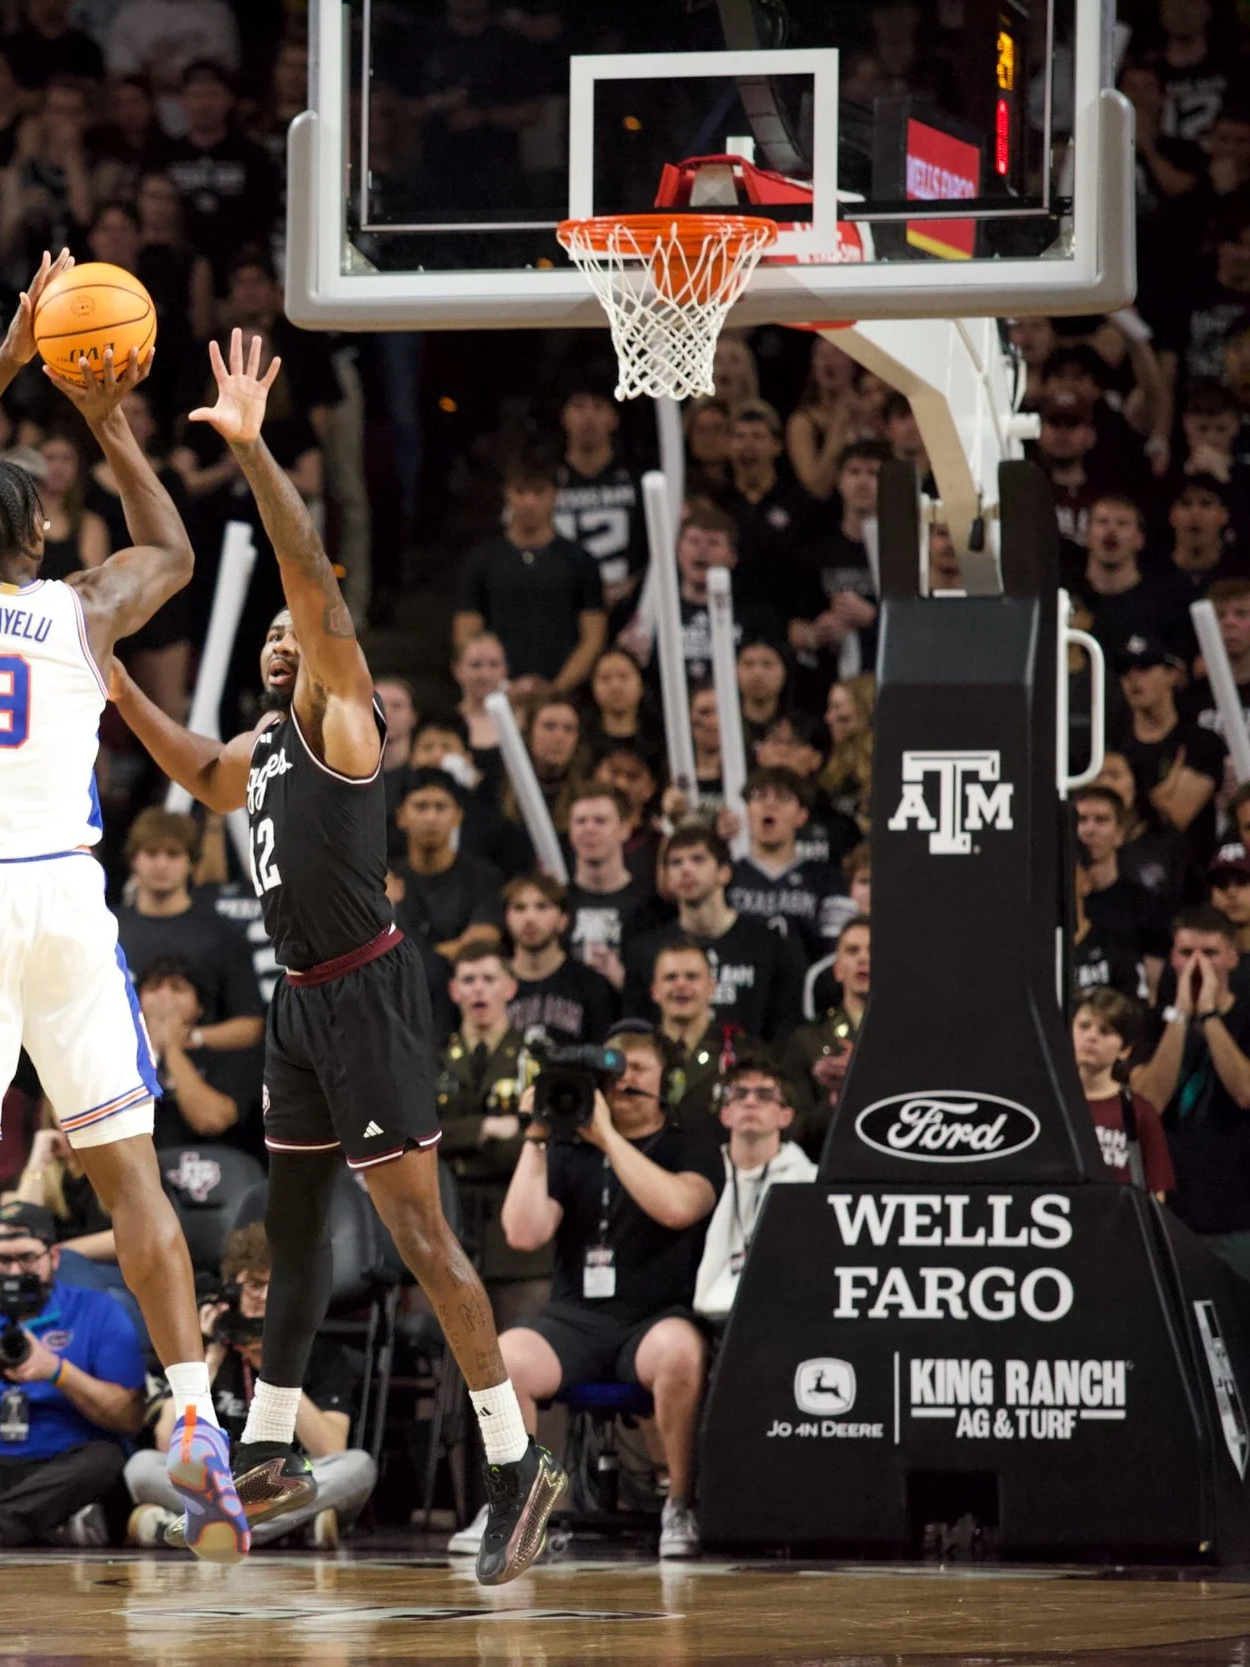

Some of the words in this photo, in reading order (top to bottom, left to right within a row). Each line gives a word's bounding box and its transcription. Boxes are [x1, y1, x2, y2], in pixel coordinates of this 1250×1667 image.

[886, 1099, 1008, 1150] Ford
[827, 1194, 1073, 1248] WELLS
[833, 1266, 1074, 1321] FARGO
[910, 1359, 994, 1405] KING
[1005, 1360, 1126, 1406] RANCH
[821, 1420, 884, 1438] DEERE
